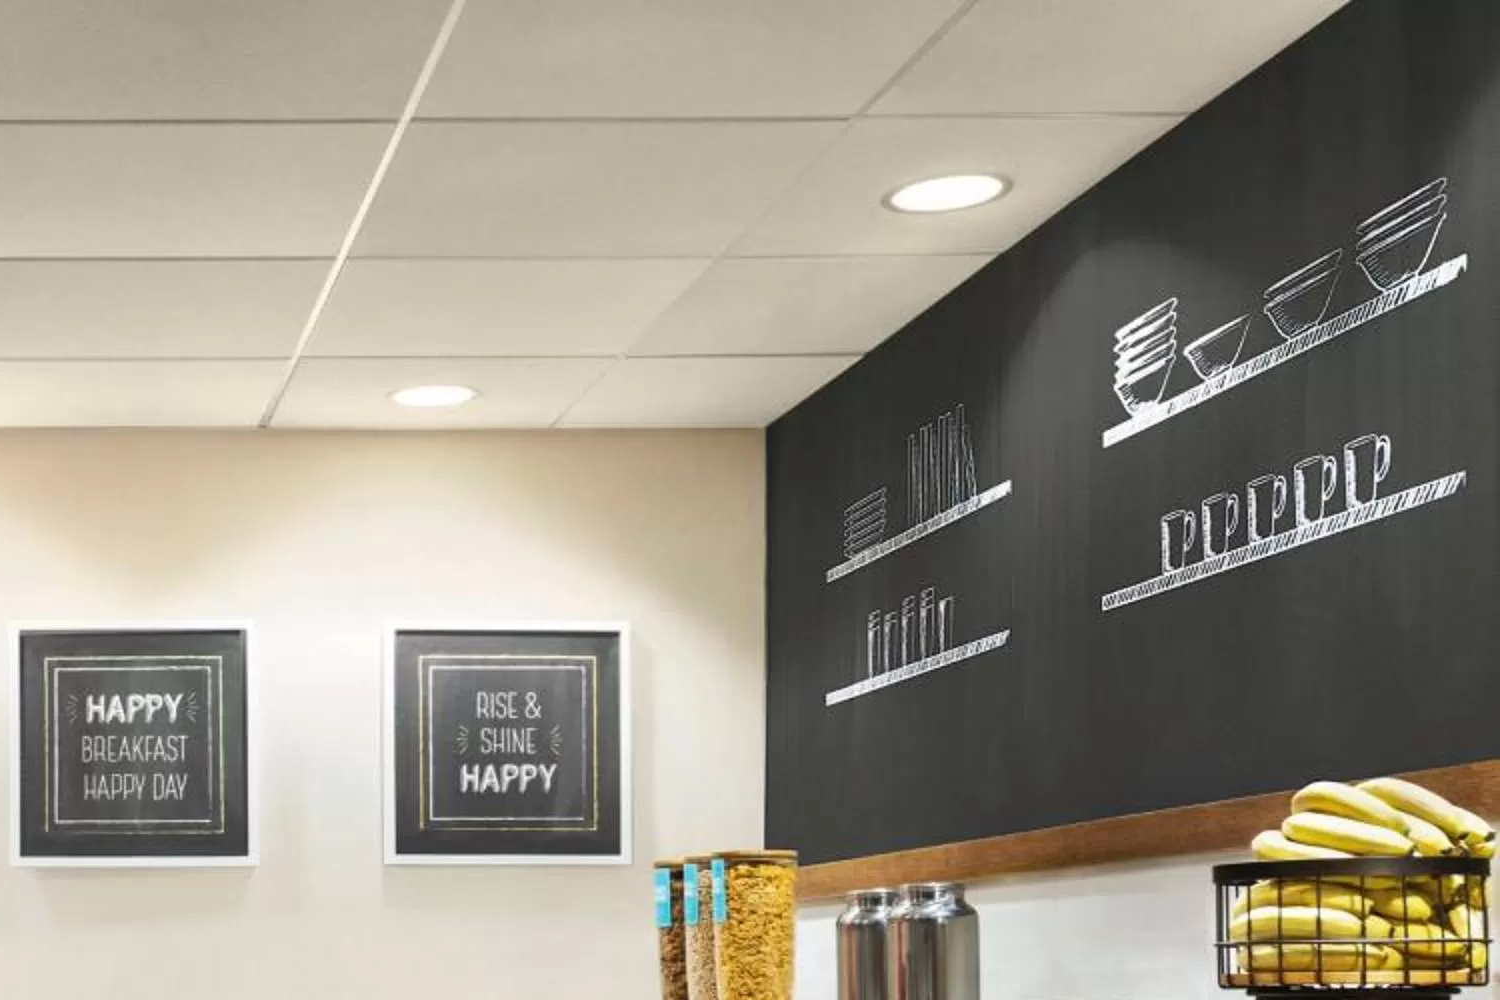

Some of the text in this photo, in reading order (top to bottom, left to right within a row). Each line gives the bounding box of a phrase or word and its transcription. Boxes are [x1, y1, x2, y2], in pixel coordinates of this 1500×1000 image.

[85, 693, 184, 725] HAPPY
[476, 691, 542, 719] RISE &
[81, 735, 189, 763] BREAKFAST
[479, 727, 539, 755] SHINE
[83, 773, 188, 800] HAPPY DAY
[460, 763, 557, 794] HAPPY
